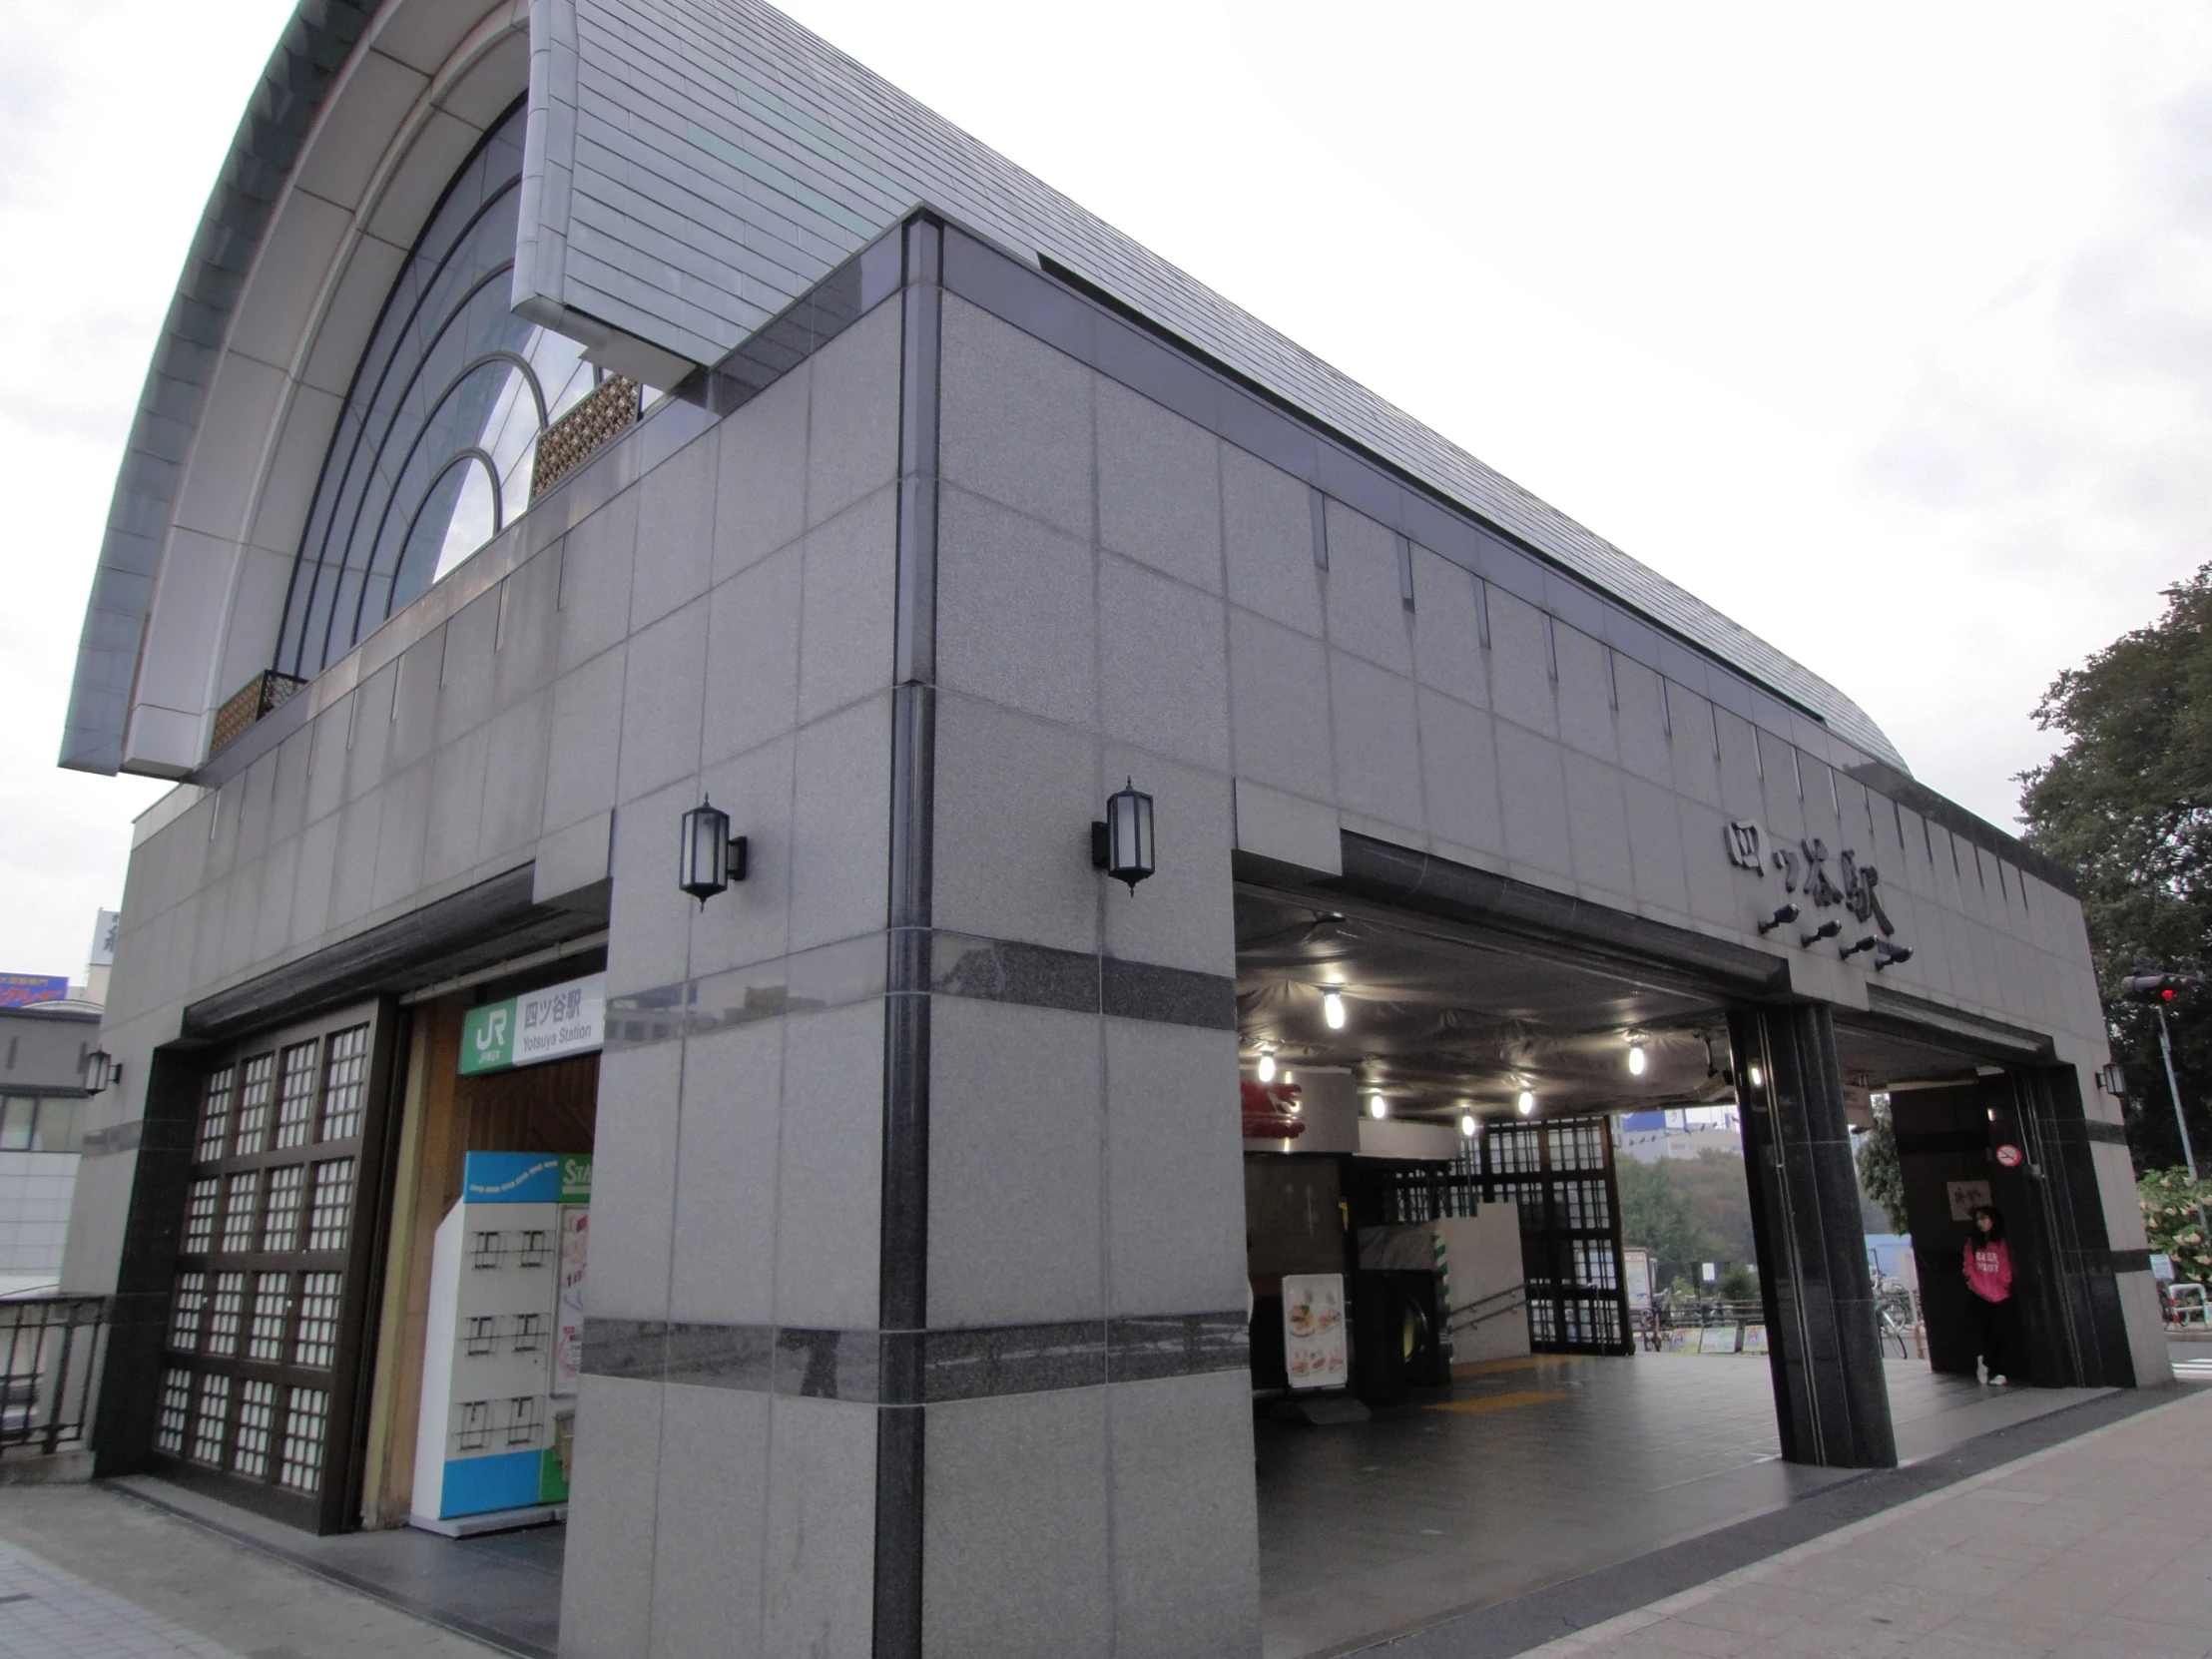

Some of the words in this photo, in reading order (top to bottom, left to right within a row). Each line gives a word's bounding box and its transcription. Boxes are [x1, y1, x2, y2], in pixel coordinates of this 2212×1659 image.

[1723, 820, 1895, 936] 四ツ谷駅
[525, 988, 581, 1028] 四ツ谷駅
[477, 1009, 507, 1050] JR
[523, 1033, 557, 1052] Yotsuya
[559, 1024, 591, 1043] Station
